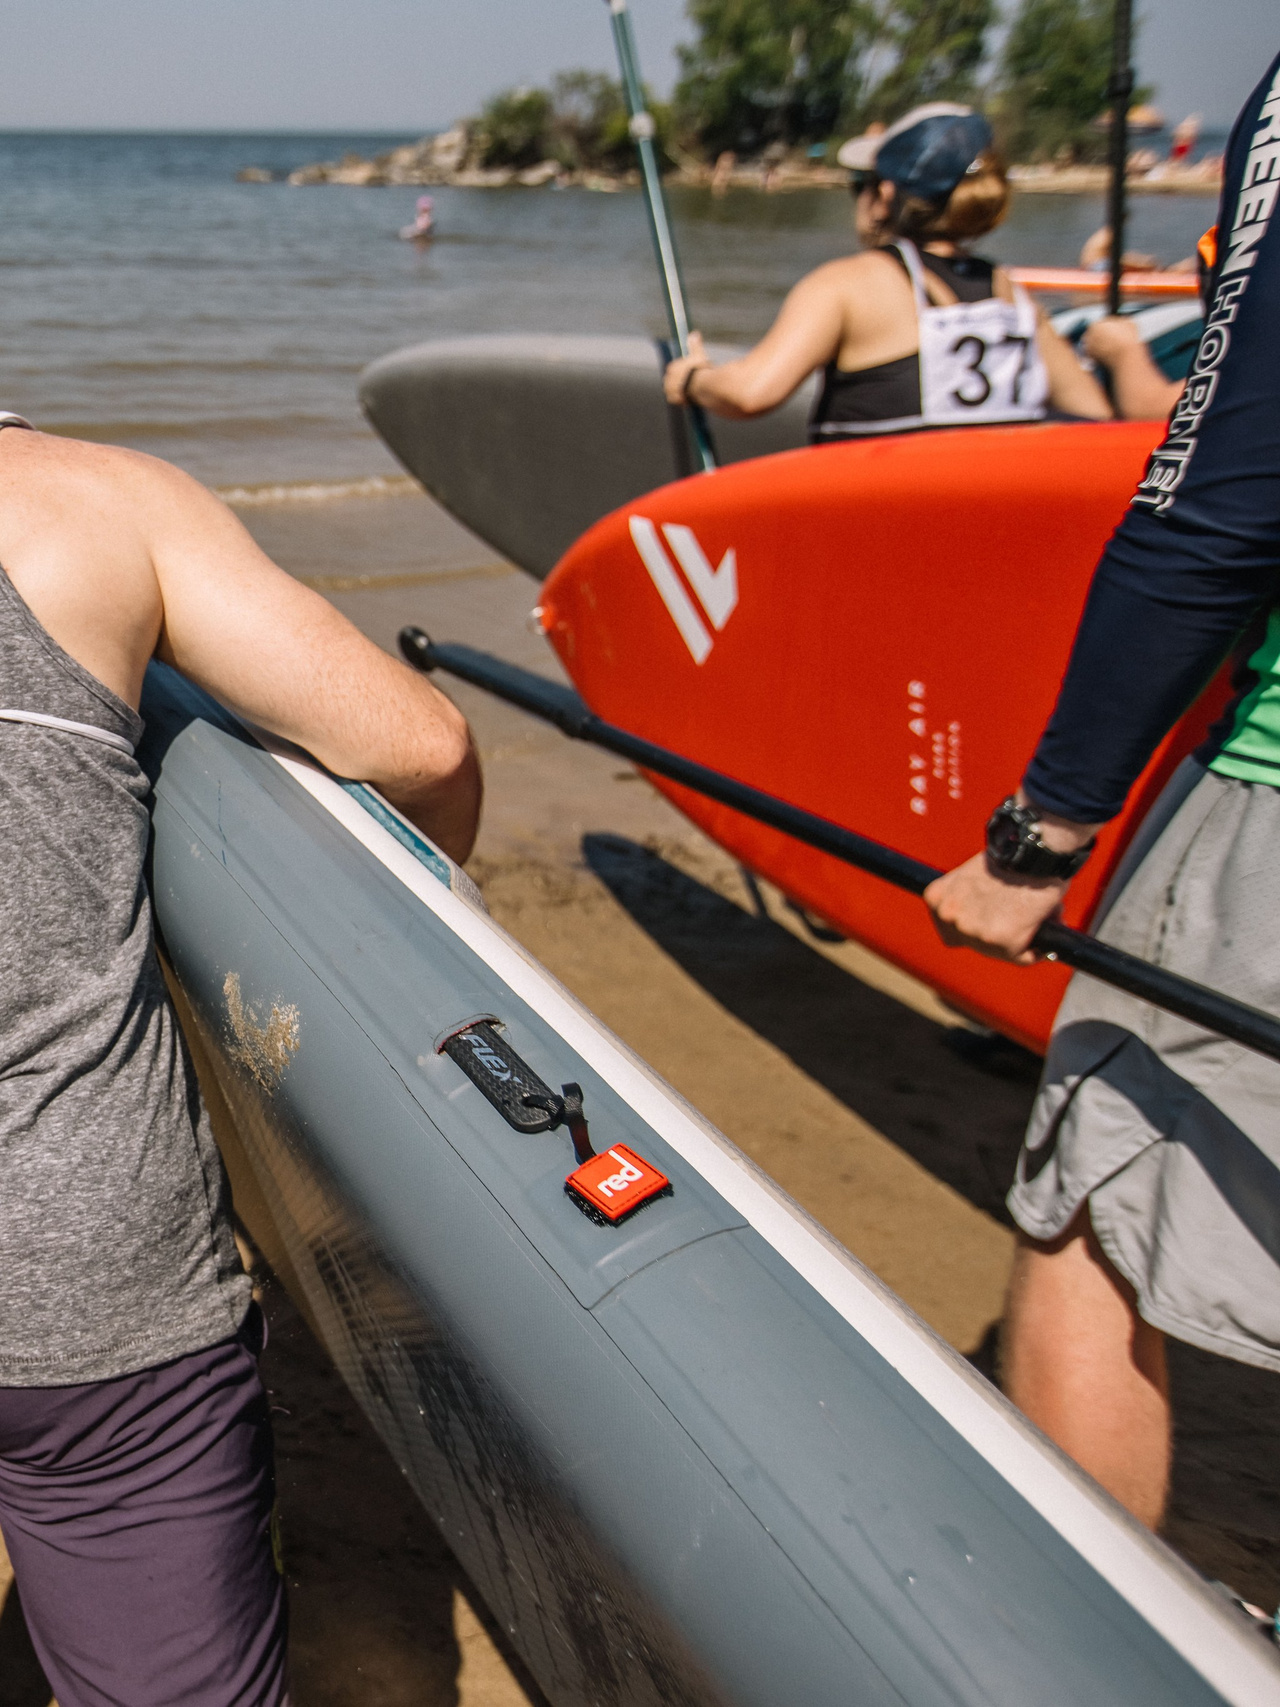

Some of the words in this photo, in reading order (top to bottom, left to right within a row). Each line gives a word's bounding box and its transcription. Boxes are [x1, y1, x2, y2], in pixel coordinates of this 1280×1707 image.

[949, 334, 1030, 407] 37
[460, 1033, 524, 1084] FLEX
[596, 1149, 644, 1198] red
